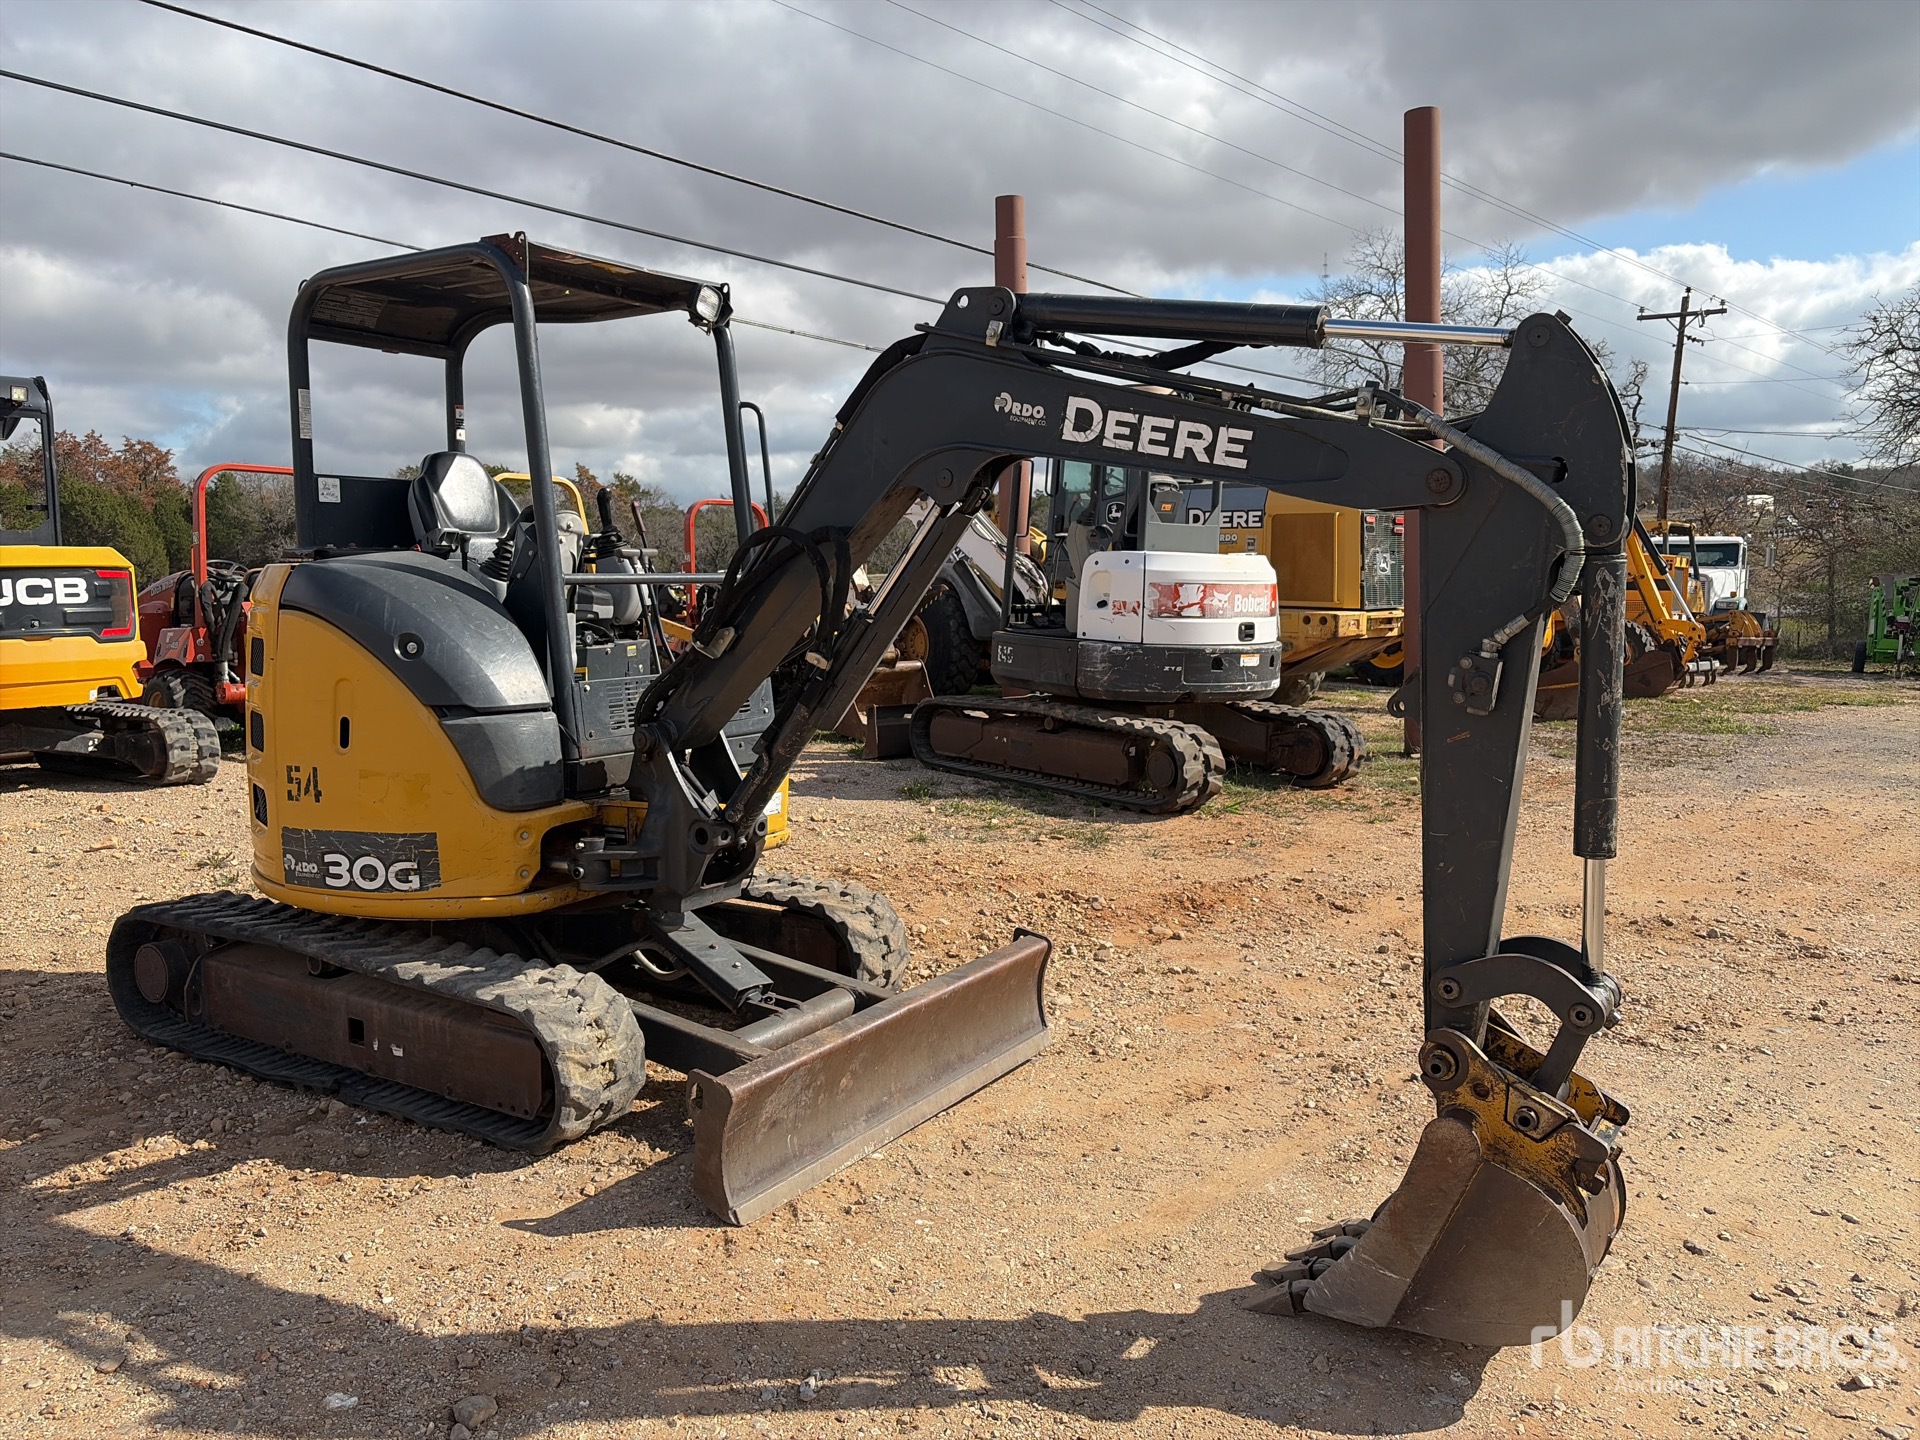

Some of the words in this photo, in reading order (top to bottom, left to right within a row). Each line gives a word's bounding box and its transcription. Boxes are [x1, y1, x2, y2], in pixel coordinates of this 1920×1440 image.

[1011, 401, 1045, 419] RDO
[1061, 395, 1254, 469] DEERE
[1187, 508, 1263, 528] DERE
[0, 577, 89, 607] JCB
[286, 765, 322, 804] 54
[323, 853, 421, 891] 30G
